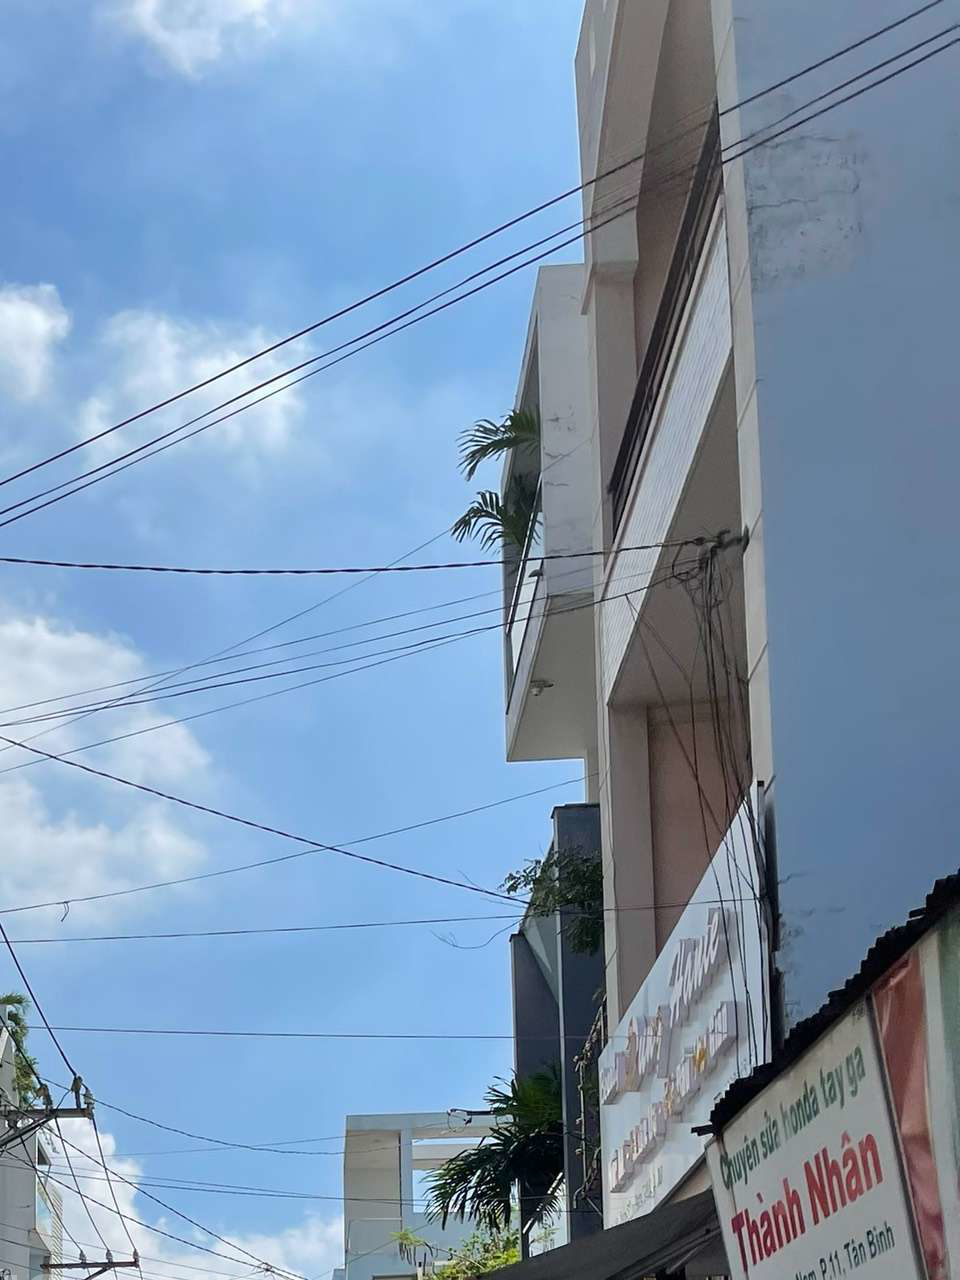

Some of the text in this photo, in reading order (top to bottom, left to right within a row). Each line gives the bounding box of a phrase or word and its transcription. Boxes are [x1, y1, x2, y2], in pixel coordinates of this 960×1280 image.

[720, 1046, 866, 1190] Chuyên sửa honda tay ga
[731, 1177, 806, 1273] Thành
[803, 1130, 883, 1226] Nhân
[844, 1238, 867, 1269] Tân
